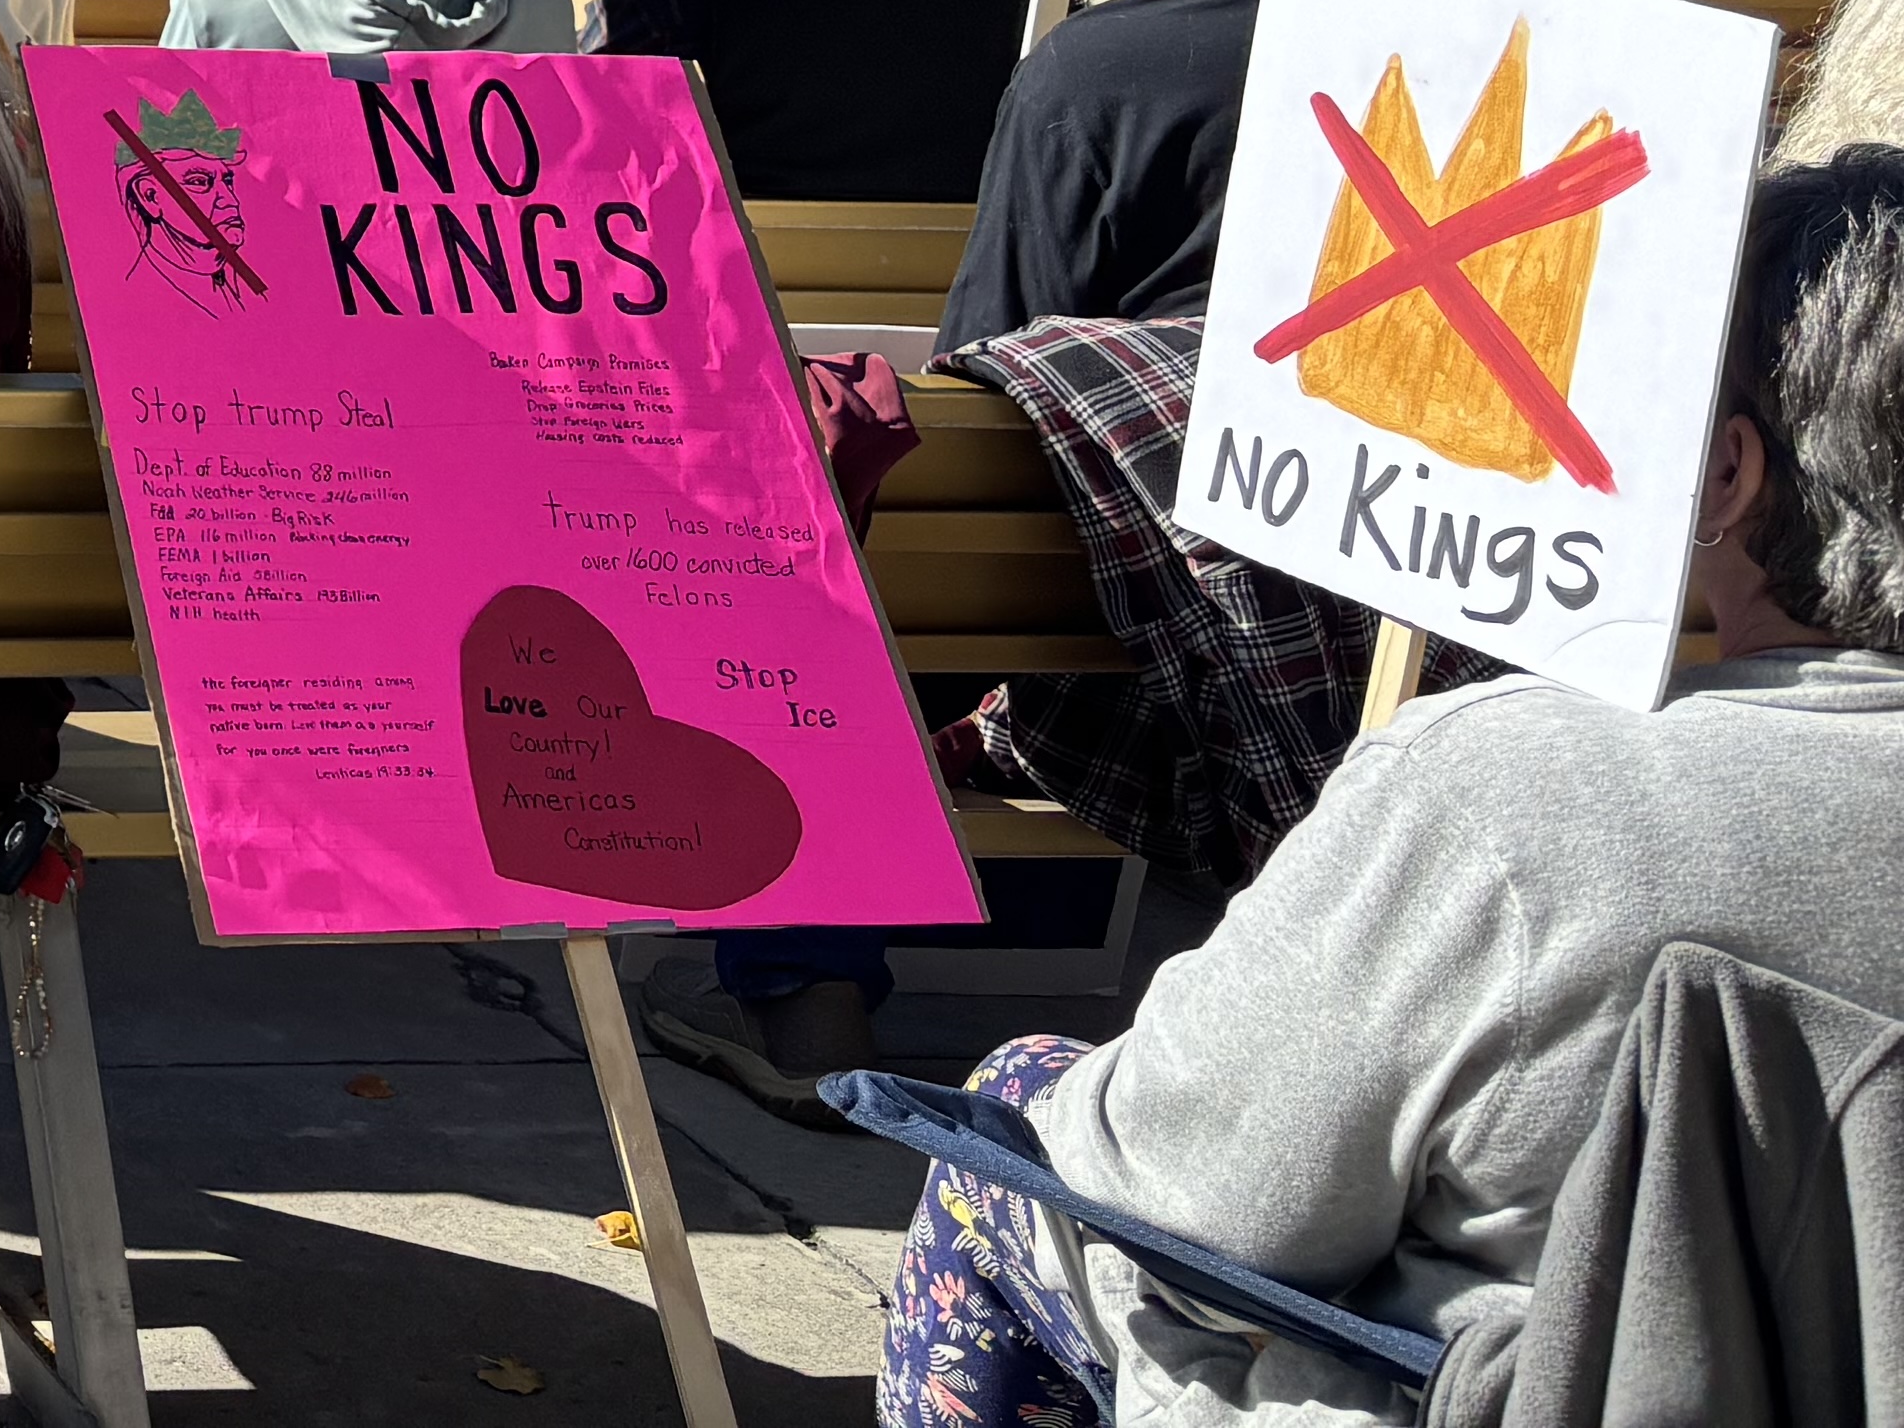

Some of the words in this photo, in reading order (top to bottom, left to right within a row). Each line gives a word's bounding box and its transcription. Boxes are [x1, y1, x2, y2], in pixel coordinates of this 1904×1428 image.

[355, 78, 541, 197] NO
[319, 202, 669, 316] KINGS
[131, 386, 206, 434] Stop
[227, 388, 323, 432] trump
[337, 389, 394, 429] Steal
[195, 456, 213, 478] of
[220, 454, 303, 479] Education
[337, 465, 392, 482] million
[1207, 427, 1309, 527] NO
[211, 507, 257, 521] billion
[542, 490, 637, 537] trump
[665, 507, 709, 536] has
[726, 516, 816, 543] released
[154, 527, 186, 543] EPA
[225, 528, 277, 543] million
[158, 547, 201, 564] FEMA
[581, 554, 621, 571] over
[625, 547, 679, 573] 1600
[686, 552, 796, 577] convicted
[160, 565, 211, 586] Foreign
[218, 566, 242, 583] Aid
[244, 585, 304, 602] Affairs
[645, 582, 734, 609] Felons
[508, 632, 557, 665] We
[716, 658, 798, 695] Stop
[484, 686, 548, 718] Love
[577, 695, 628, 720] Our
[785, 701, 837, 728] Ice
[545, 764, 577, 782] and
[502, 782, 636, 812] Americas
